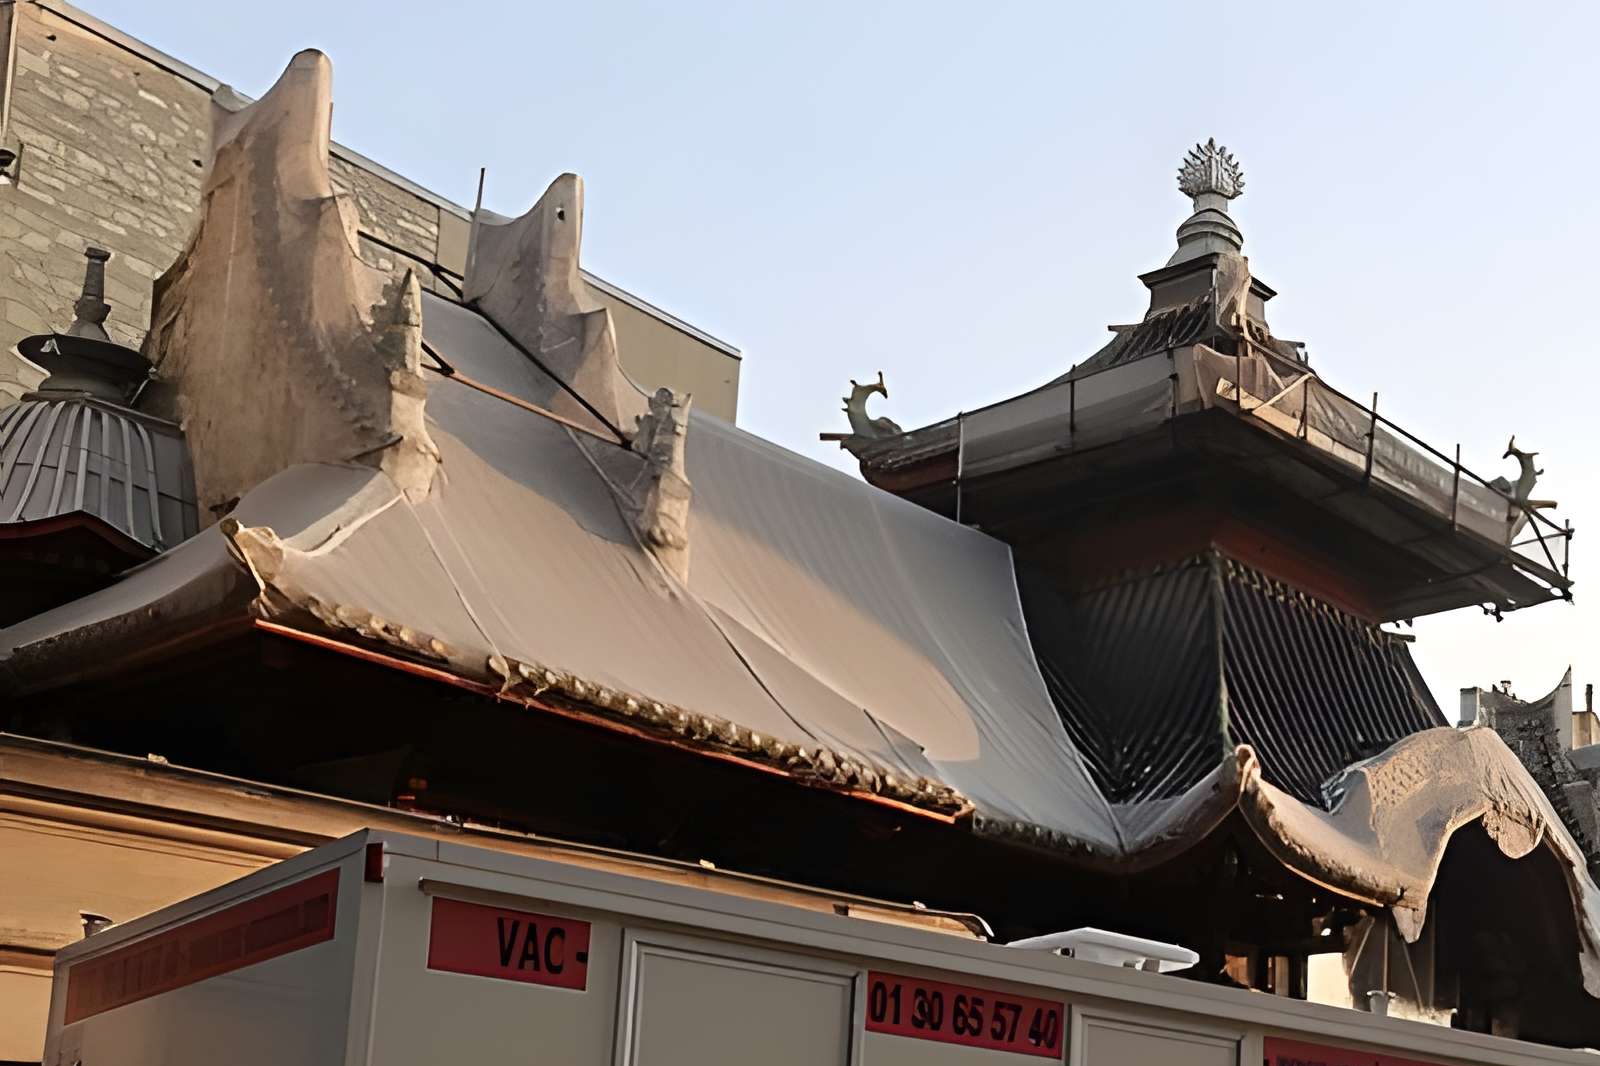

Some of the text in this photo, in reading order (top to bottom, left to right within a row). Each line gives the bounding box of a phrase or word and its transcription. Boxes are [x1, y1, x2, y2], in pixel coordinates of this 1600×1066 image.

[497, 917, 566, 974] VAC
[870, 981, 902, 1024] 01
[952, 994, 985, 1037] 65
[990, 1001, 1024, 1042] 57
